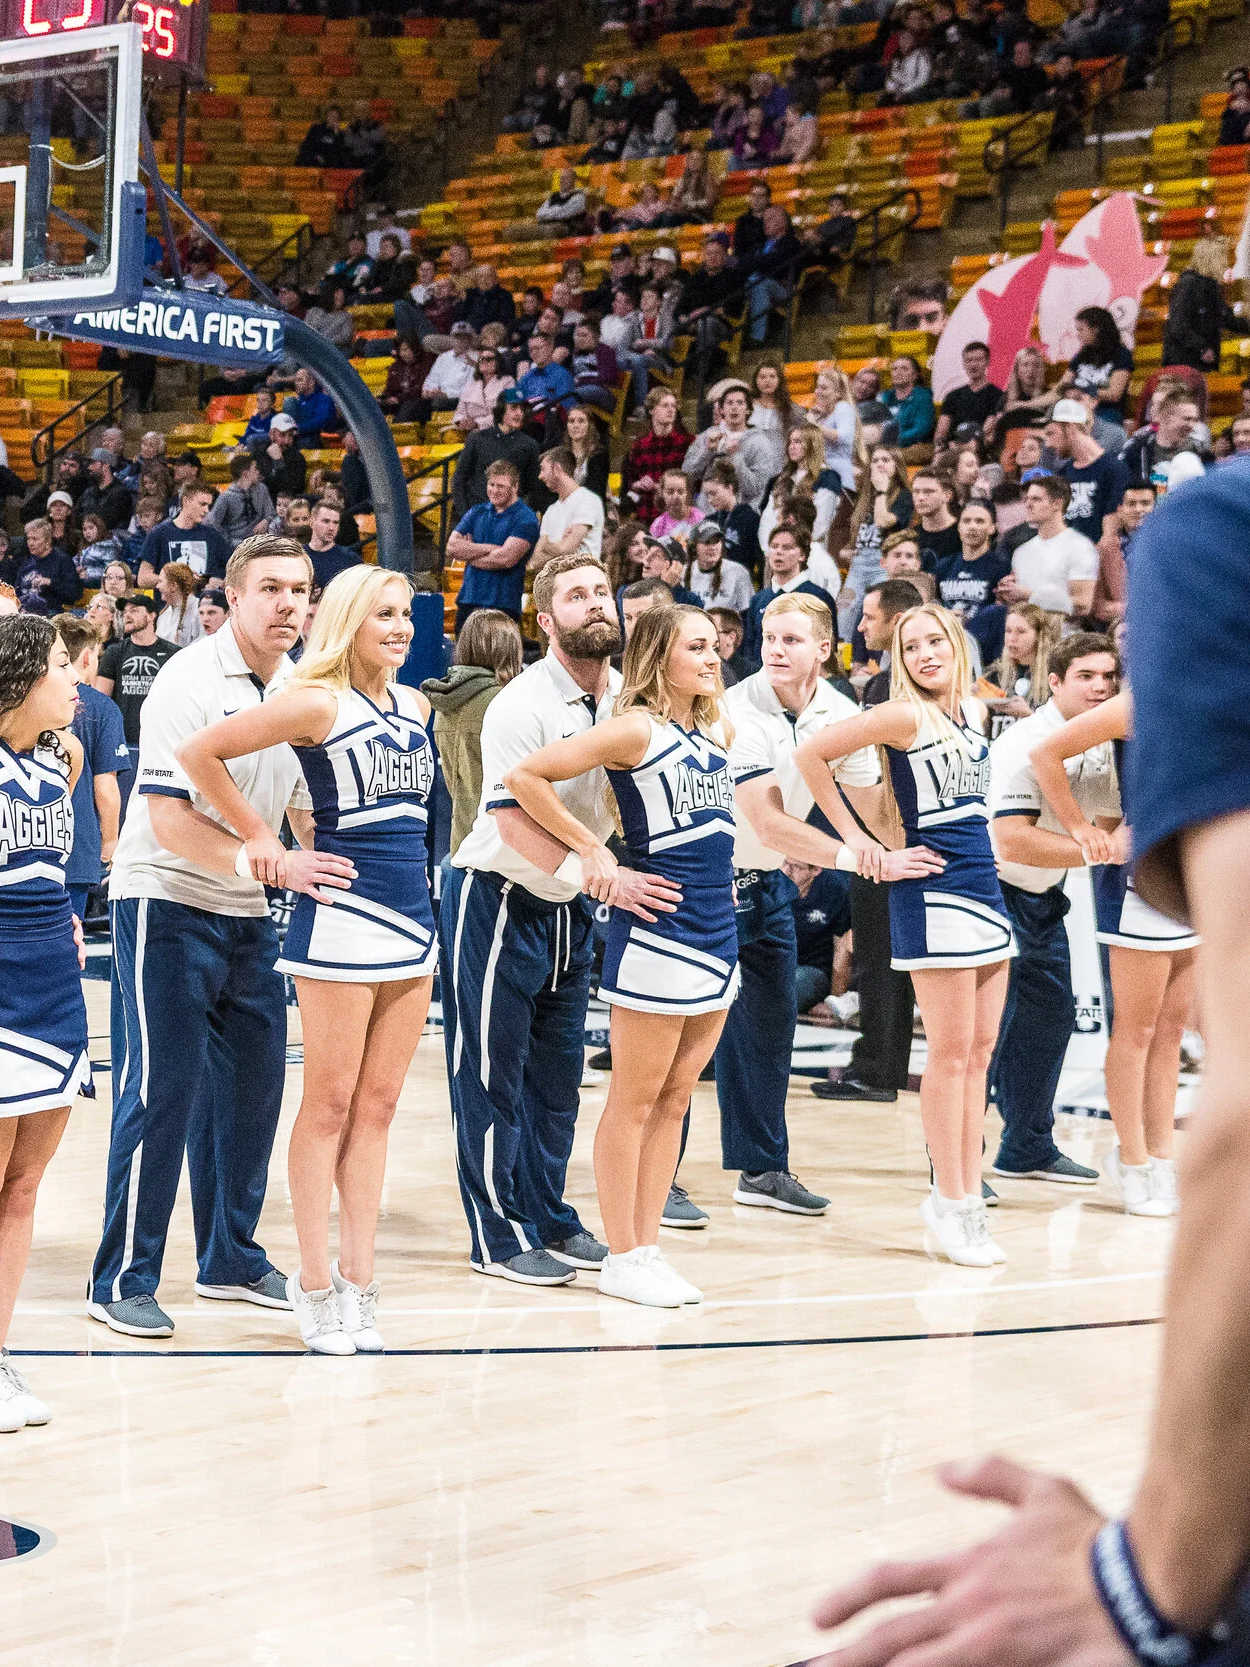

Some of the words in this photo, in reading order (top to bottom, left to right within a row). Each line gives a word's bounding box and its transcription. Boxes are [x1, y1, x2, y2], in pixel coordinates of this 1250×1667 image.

[202, 312, 280, 352] FIRST
[121, 685, 150, 695] AGGI
[155, 769, 174, 778] STATE
[366, 740, 434, 797] AGGIES
[939, 749, 991, 799] AGGIE
[736, 872, 758, 889] GES
